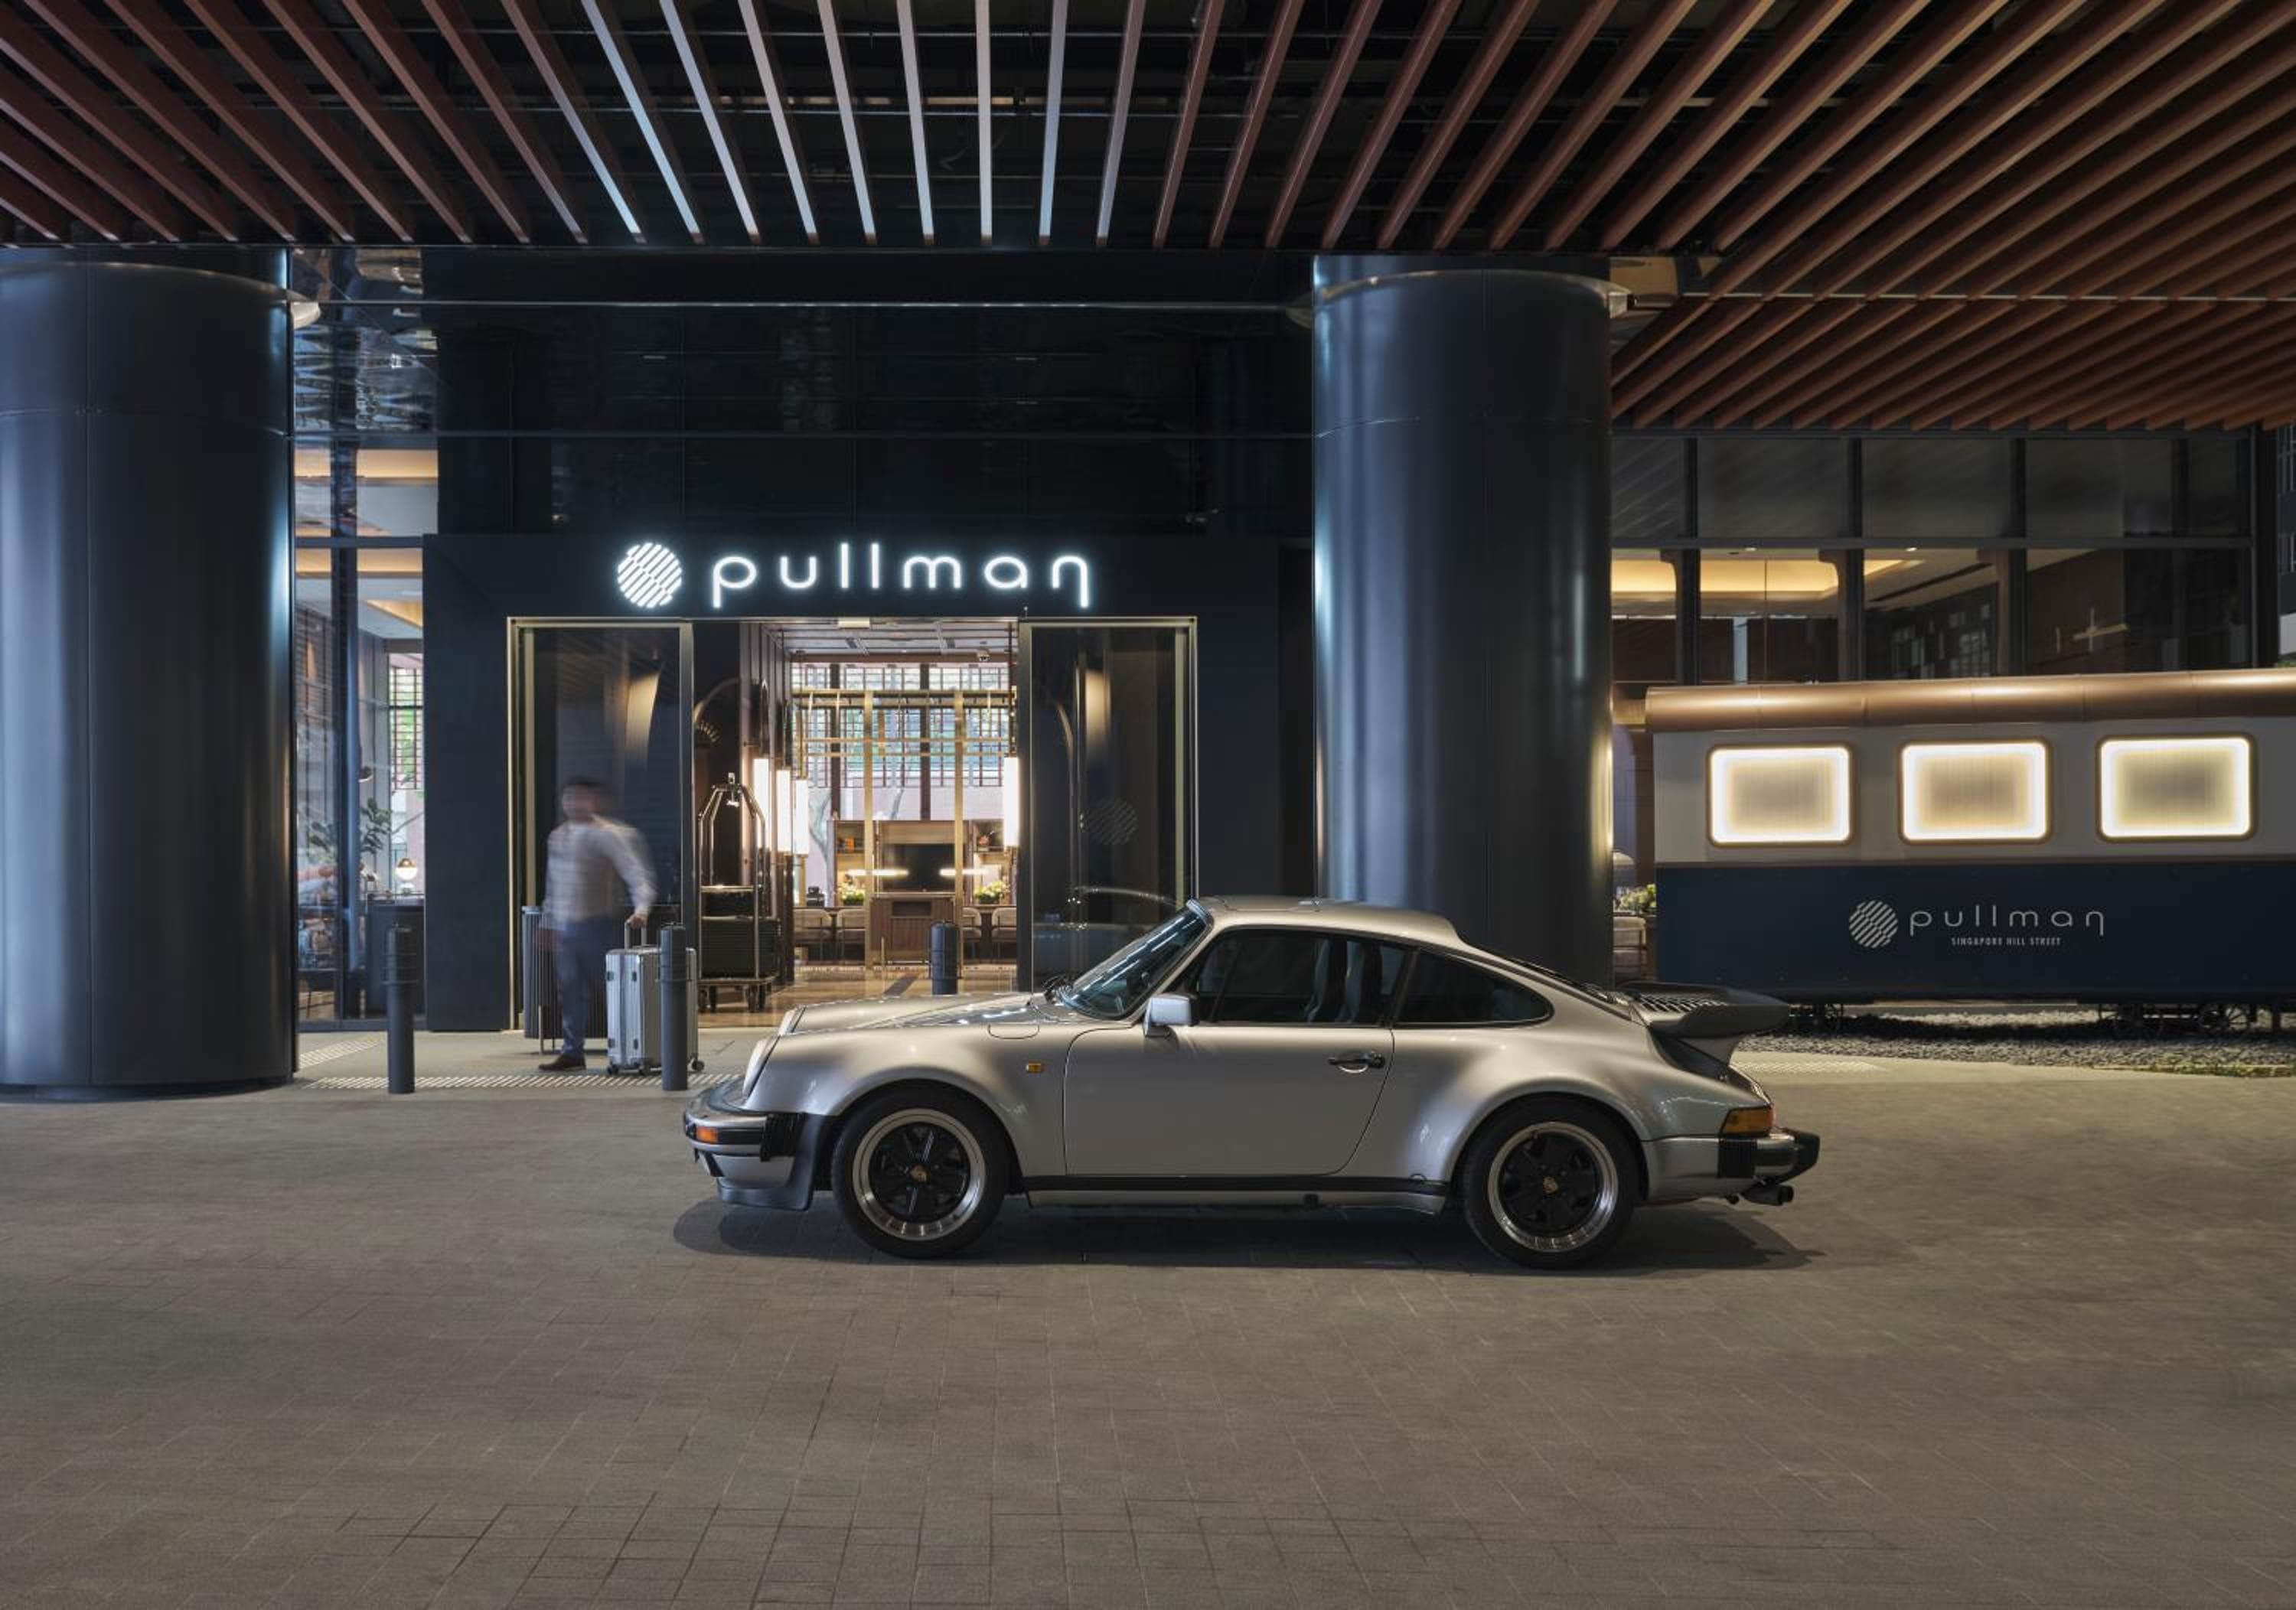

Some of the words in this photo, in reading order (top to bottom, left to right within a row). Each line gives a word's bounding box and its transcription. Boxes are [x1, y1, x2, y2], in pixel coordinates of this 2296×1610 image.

[712, 543, 1089, 608] pullman
[1910, 904, 2104, 936] pullman
[1951, 937, 2003, 947] SINGAPORE
[2006, 937, 2025, 947] HILL
[2030, 937, 2061, 947] STREET
